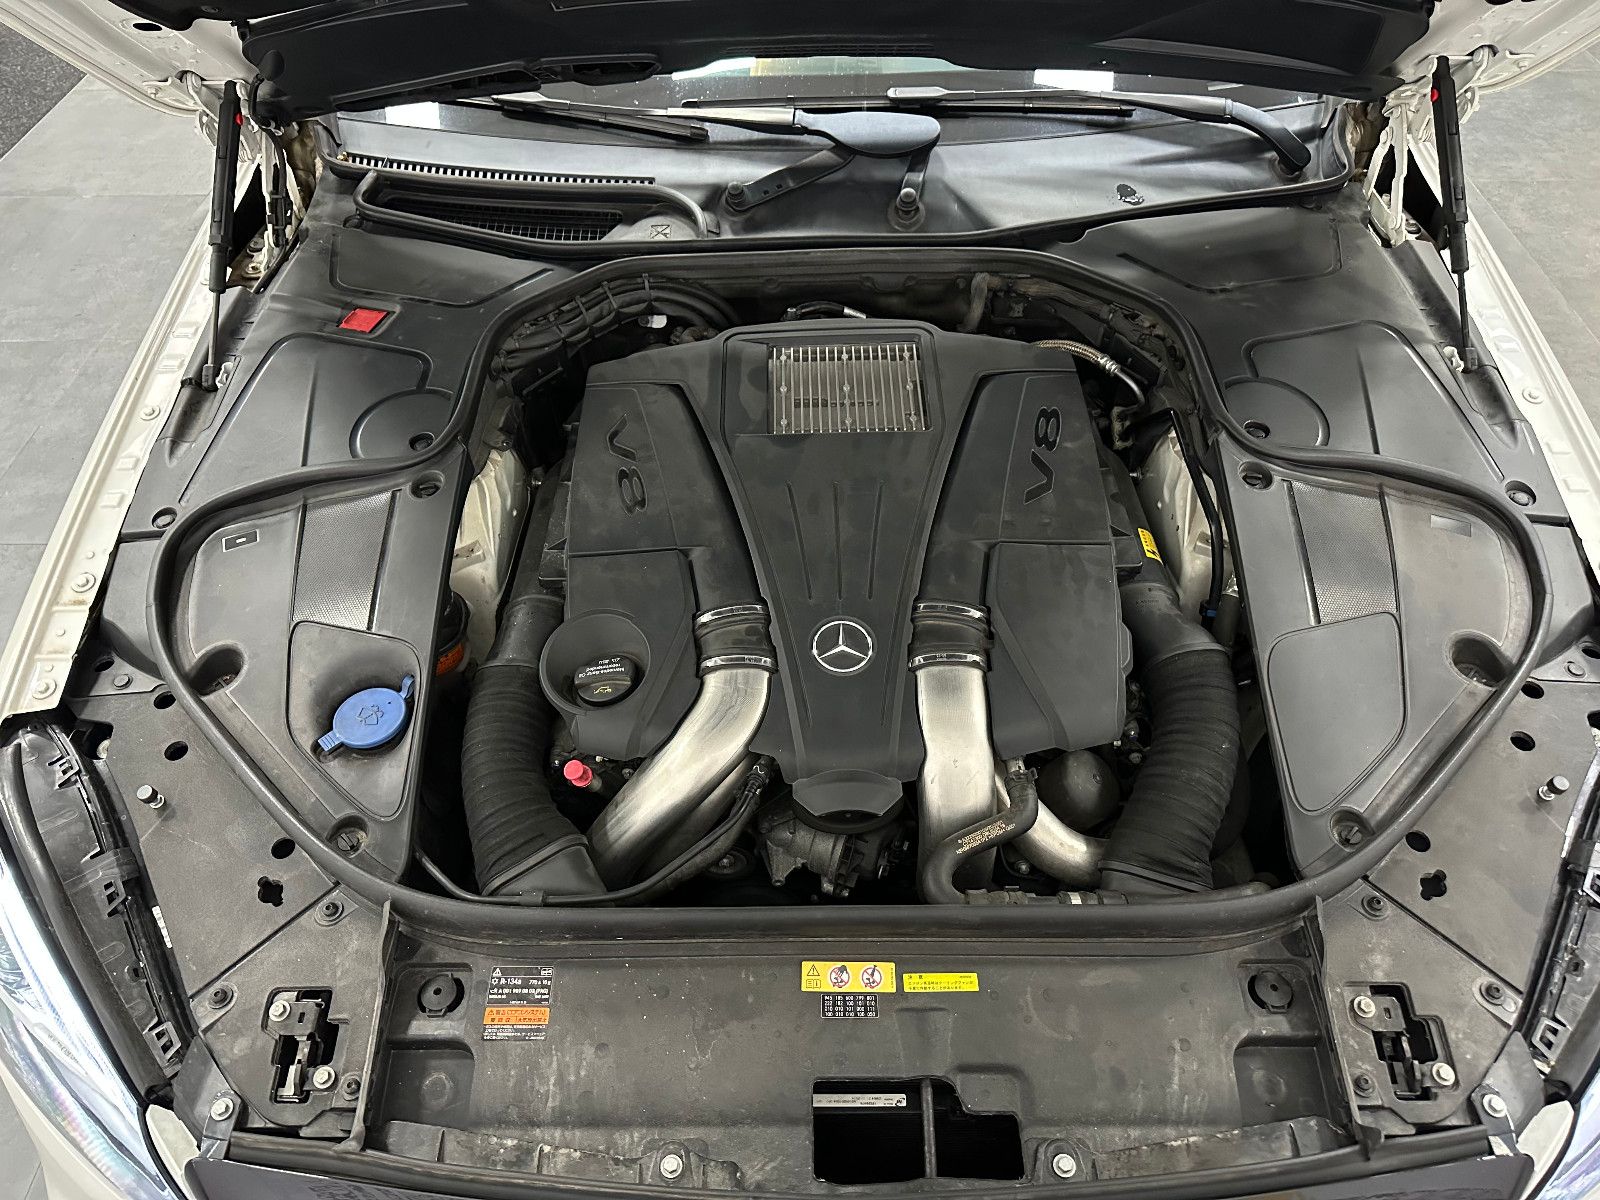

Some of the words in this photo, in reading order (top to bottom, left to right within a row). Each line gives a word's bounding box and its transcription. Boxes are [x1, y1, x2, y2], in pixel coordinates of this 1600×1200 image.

[606, 413, 648, 517] V8
[1023, 406, 1062, 506] V8
[500, 977, 522, 985] R-134a
